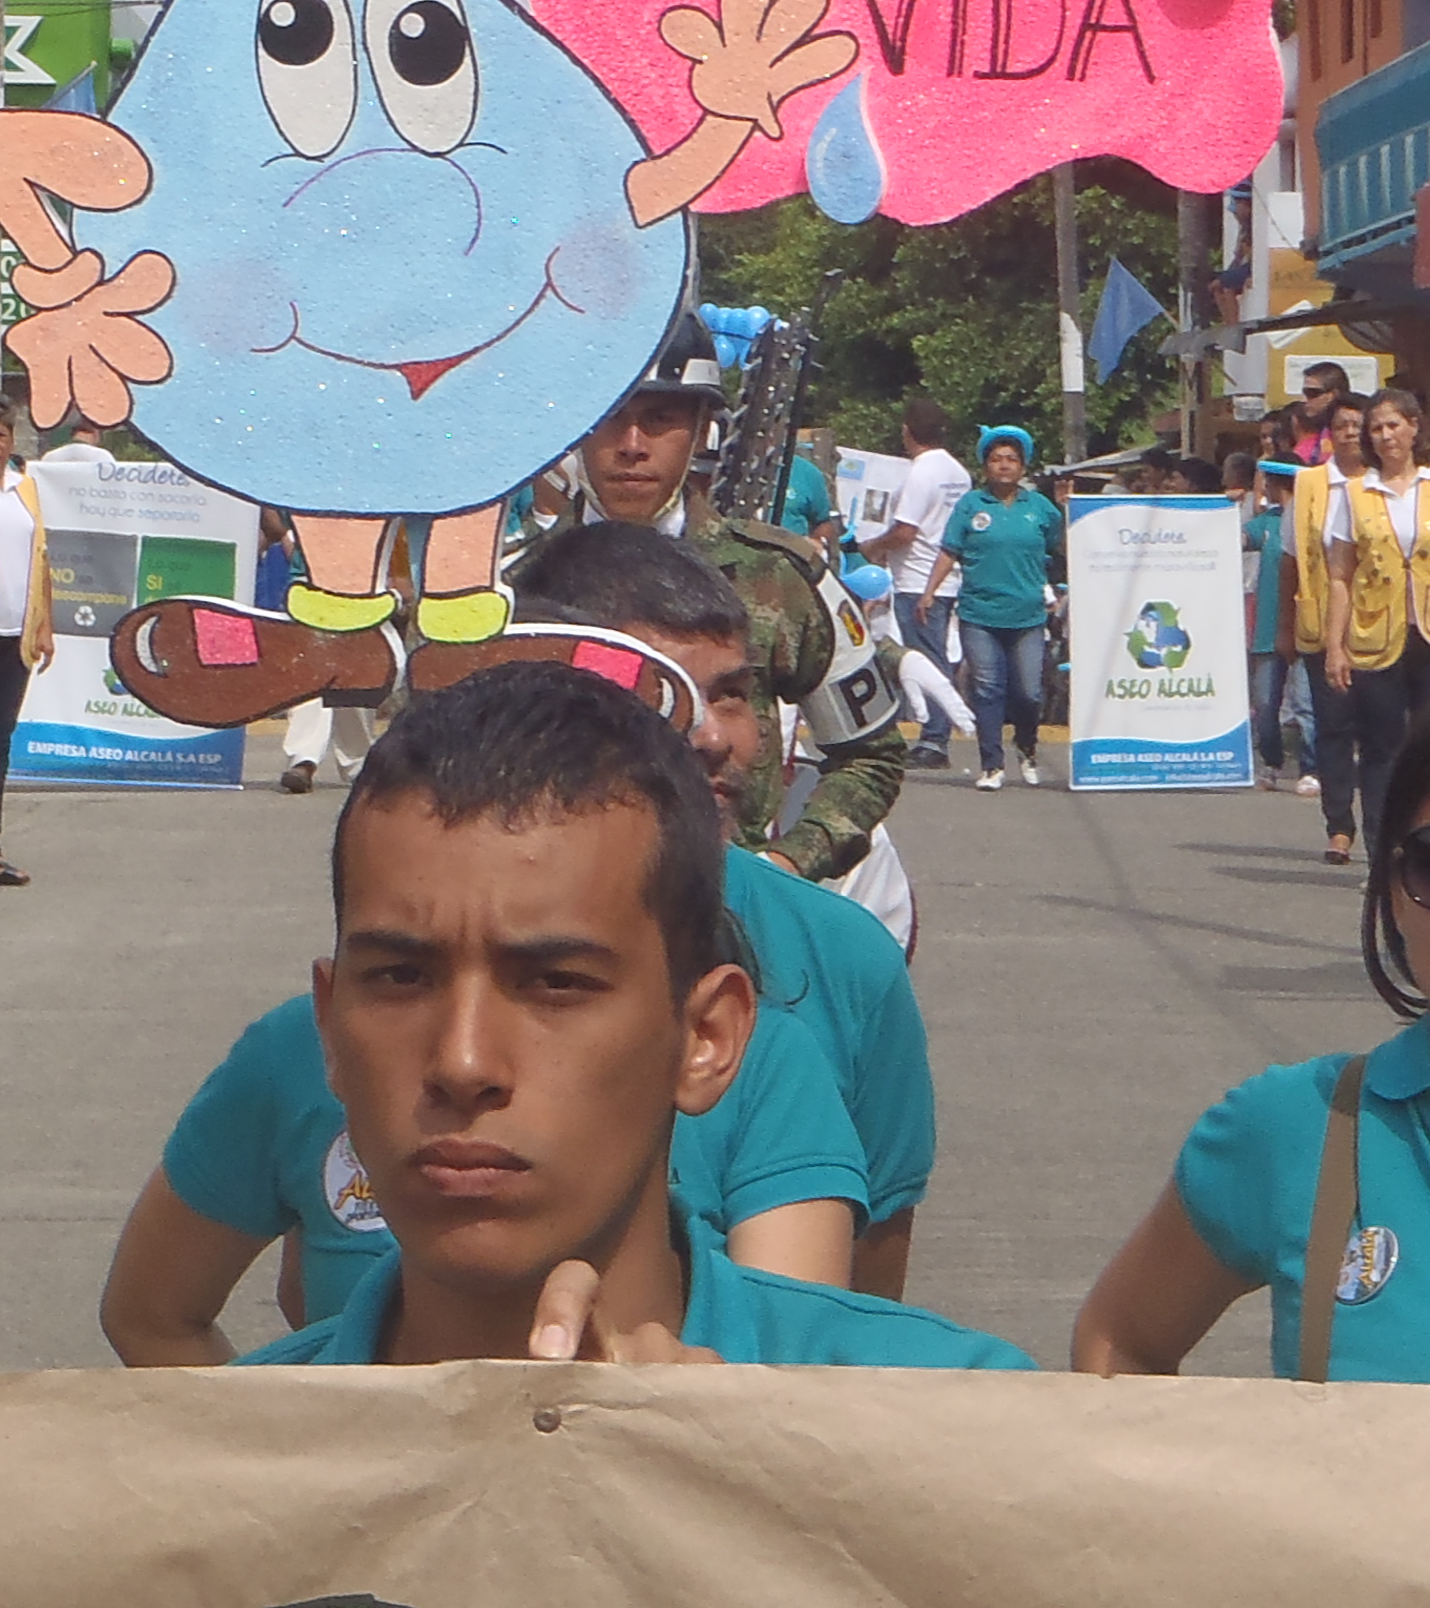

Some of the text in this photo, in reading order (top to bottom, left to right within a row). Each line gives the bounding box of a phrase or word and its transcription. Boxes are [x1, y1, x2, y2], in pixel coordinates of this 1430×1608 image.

[1105, 677, 1152, 700] ASEO
[84, 699, 118, 715] ASEO
[27, 740, 87, 758] EMPRESA
[88, 745, 123, 761] ASEO
[198, 752, 223, 765] ESP
